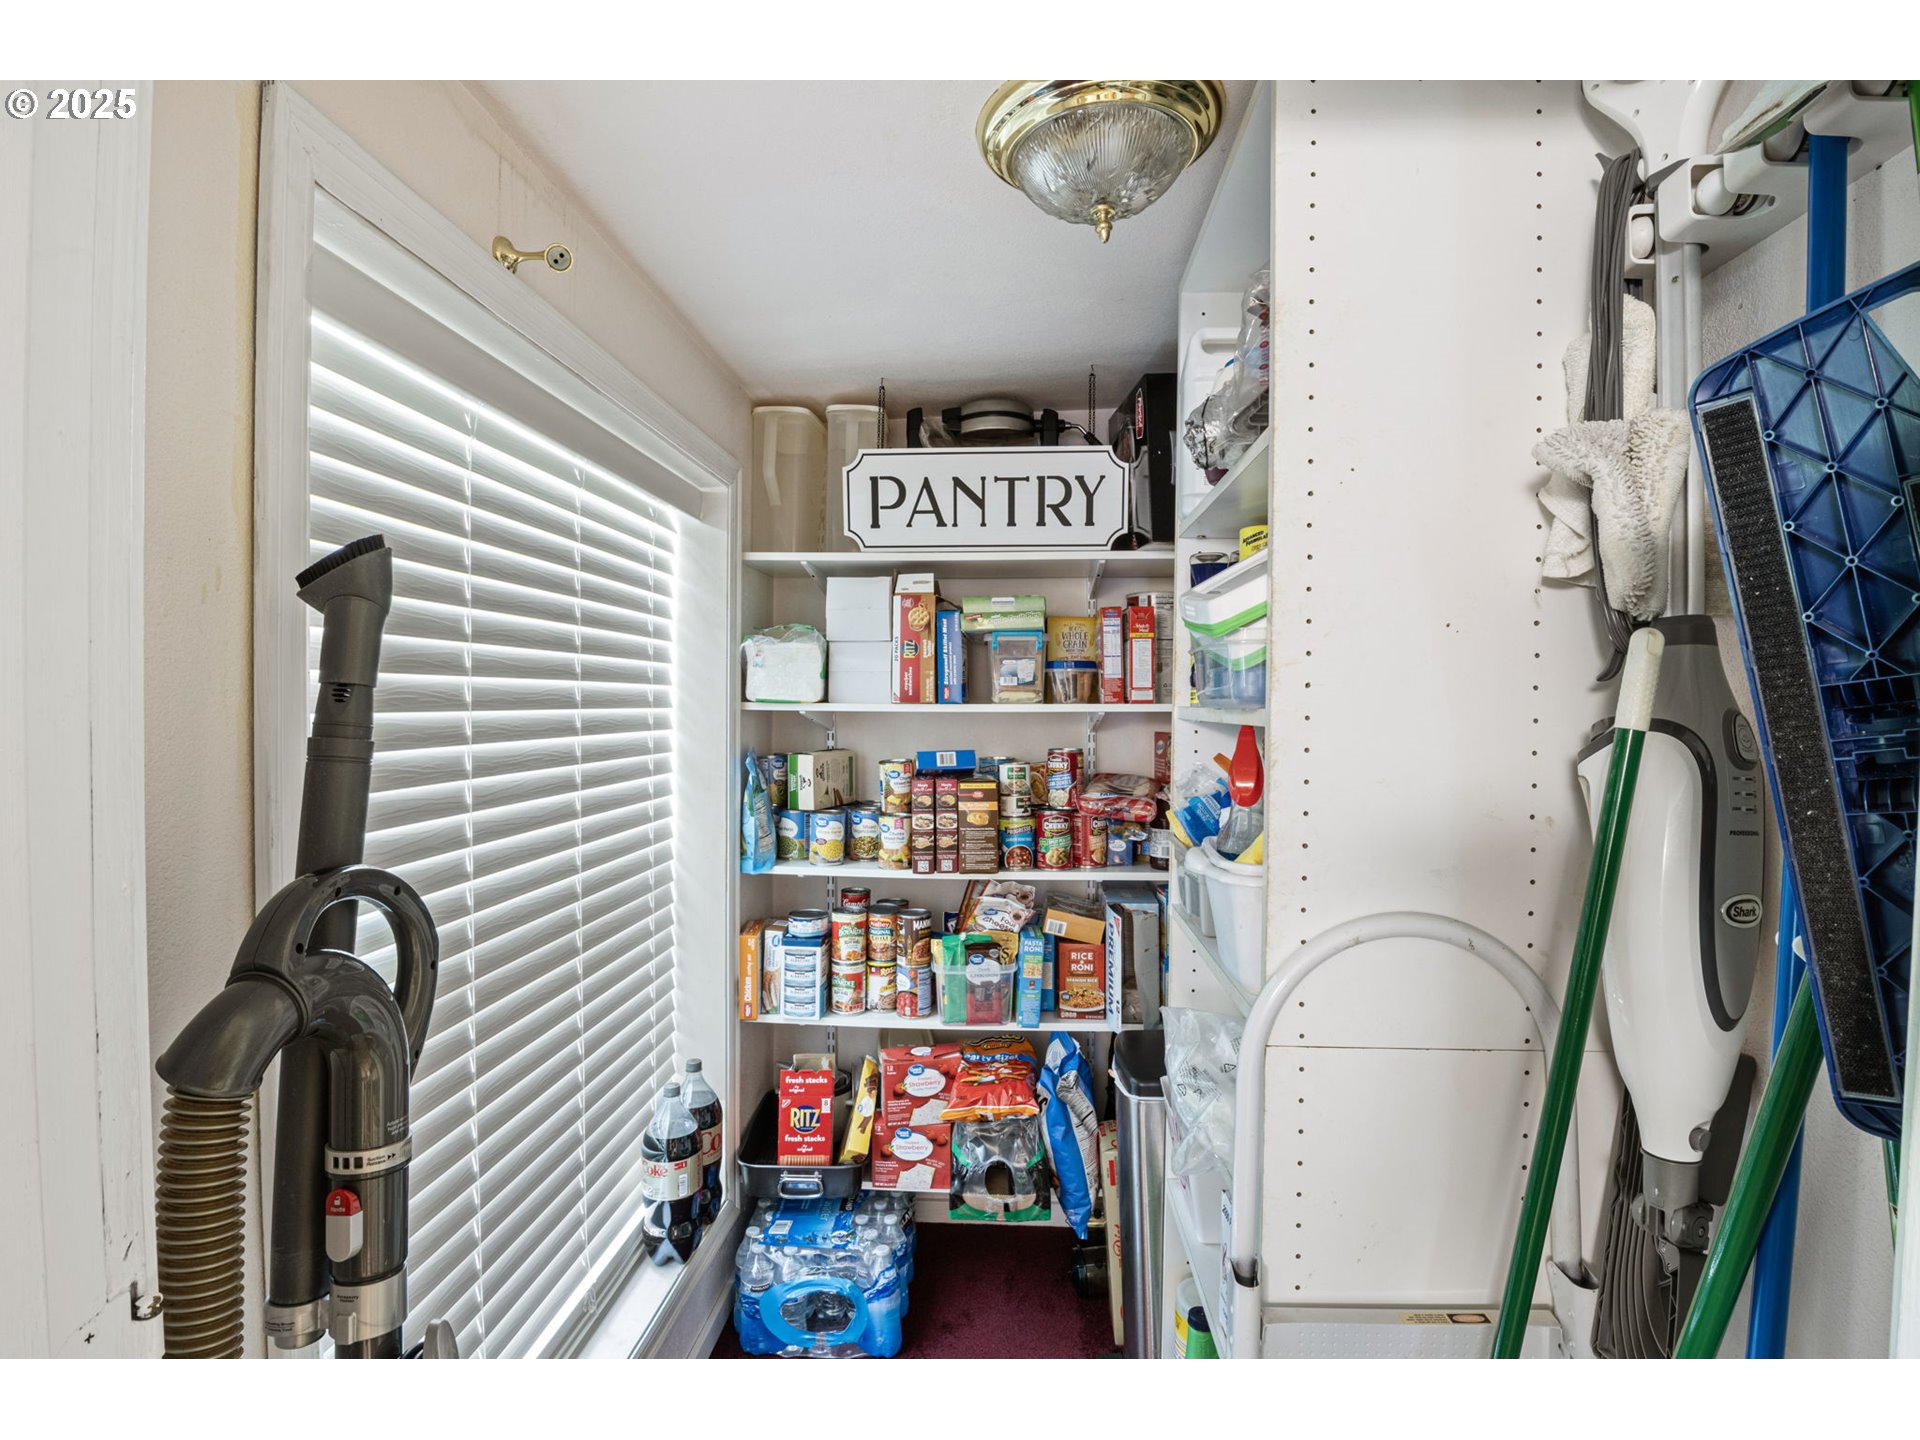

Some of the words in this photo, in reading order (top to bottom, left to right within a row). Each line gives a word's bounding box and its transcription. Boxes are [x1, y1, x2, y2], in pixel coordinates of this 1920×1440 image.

[869, 474, 1107, 530] PANTRY
[1061, 632, 1089, 640] WHOLE
[902, 639, 916, 659] RITZ
[1062, 640, 1088, 649] GRAIN
[1733, 906, 1757, 919] Shark
[1000, 916, 1017, 928] Four
[1023, 945, 1043, 953] RONI
[1071, 952, 1093, 960] RICE
[1071, 962, 1093, 971] RONI
[1107, 923, 1115, 1015] PREMIUM
[785, 1076, 804, 1084] fresh
[805, 1076, 828, 1084] stacks
[908, 1079, 941, 1089] Strawberry
[790, 1107, 821, 1129] RITZ
[785, 1134, 803, 1142] fresh
[700, 1131, 721, 1155] Co
[895, 1144, 929, 1153] Strawberry
